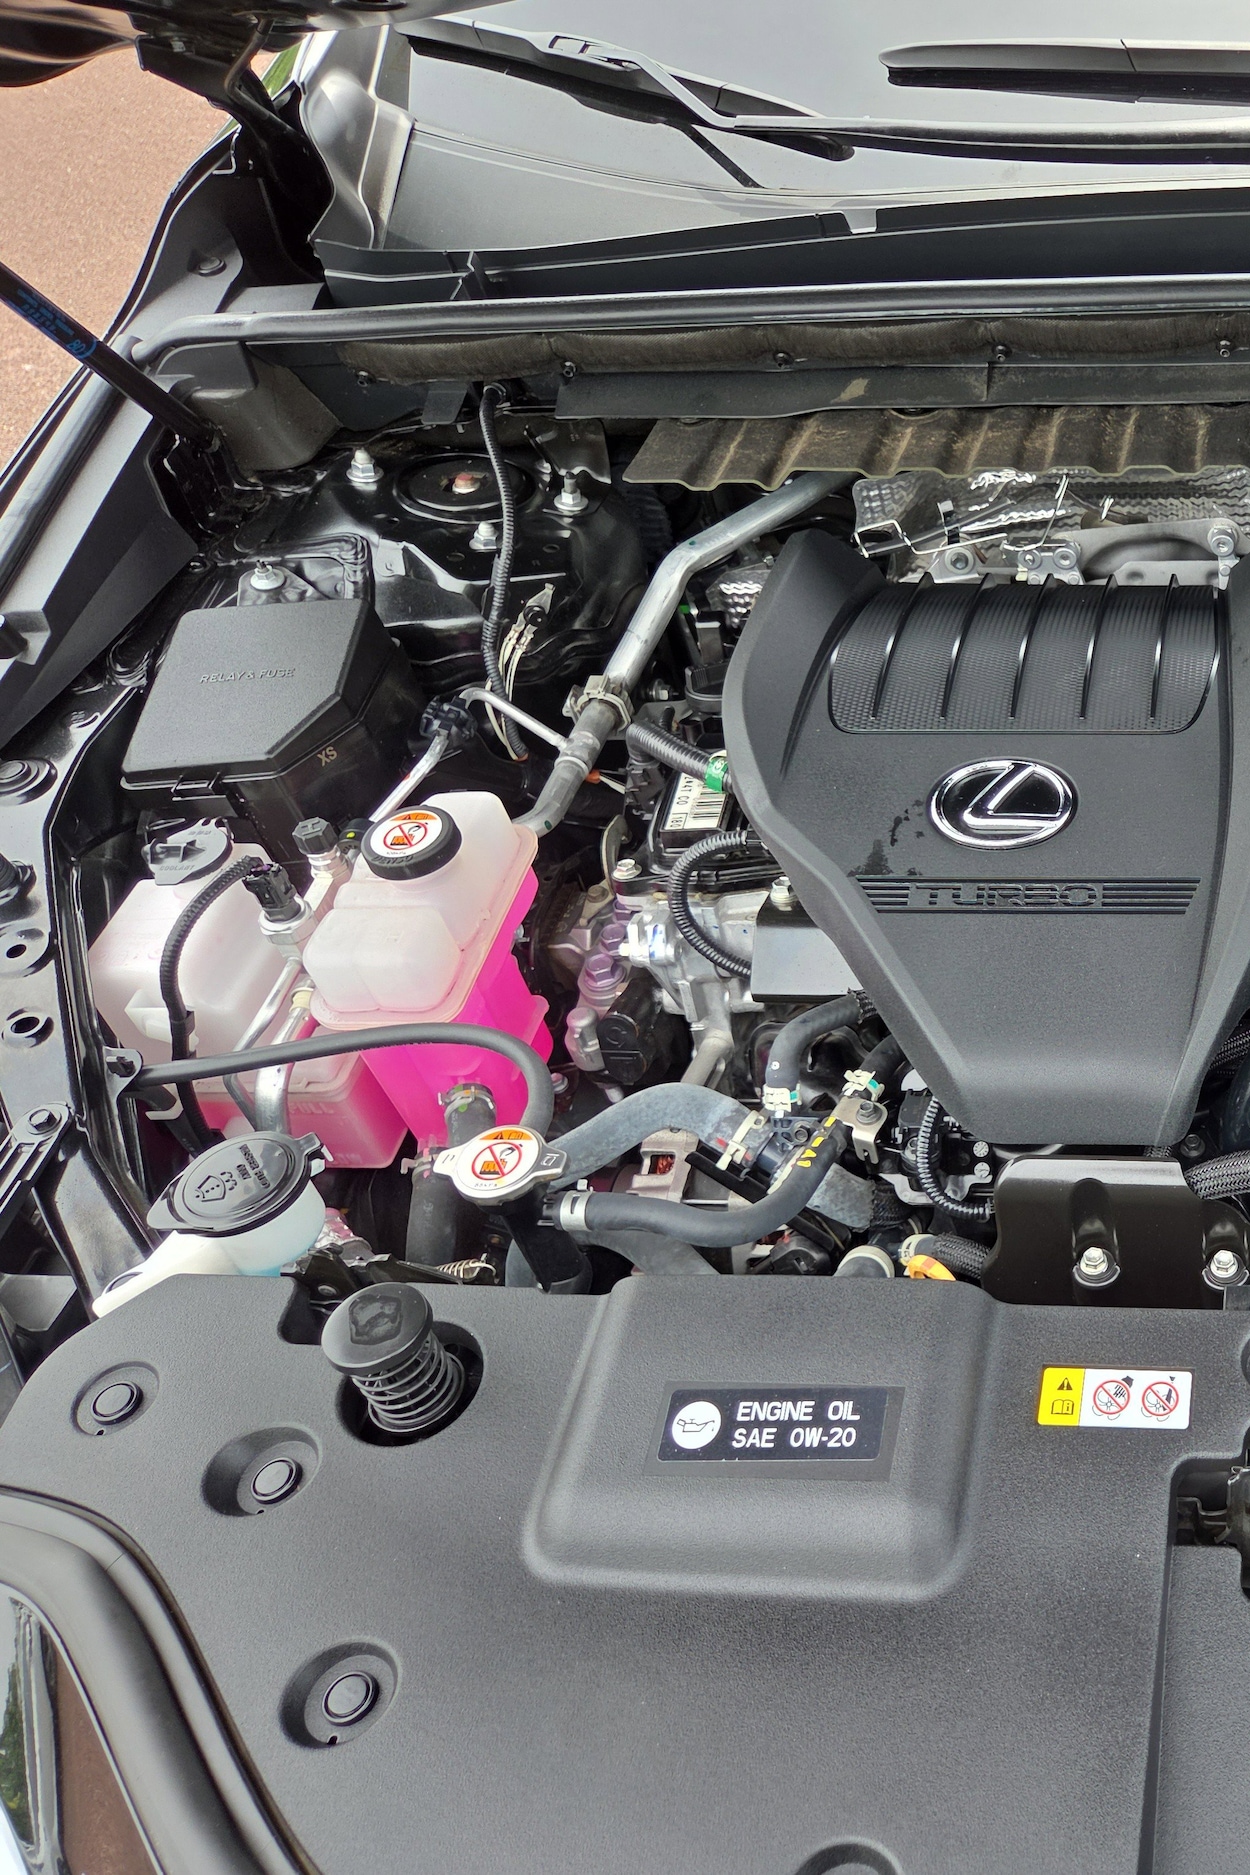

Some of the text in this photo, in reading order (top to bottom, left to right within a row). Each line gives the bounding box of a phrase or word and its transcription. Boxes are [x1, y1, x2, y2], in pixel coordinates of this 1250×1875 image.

[199, 668, 296, 684] RELAY & FUSE
[317, 746, 338, 767] XS
[670, 816, 684, 828] 180
[915, 883, 1098, 907] TURBO
[736, 1400, 861, 1422] ENGINE OIL
[732, 1427, 857, 1449] SAE 0W-20
